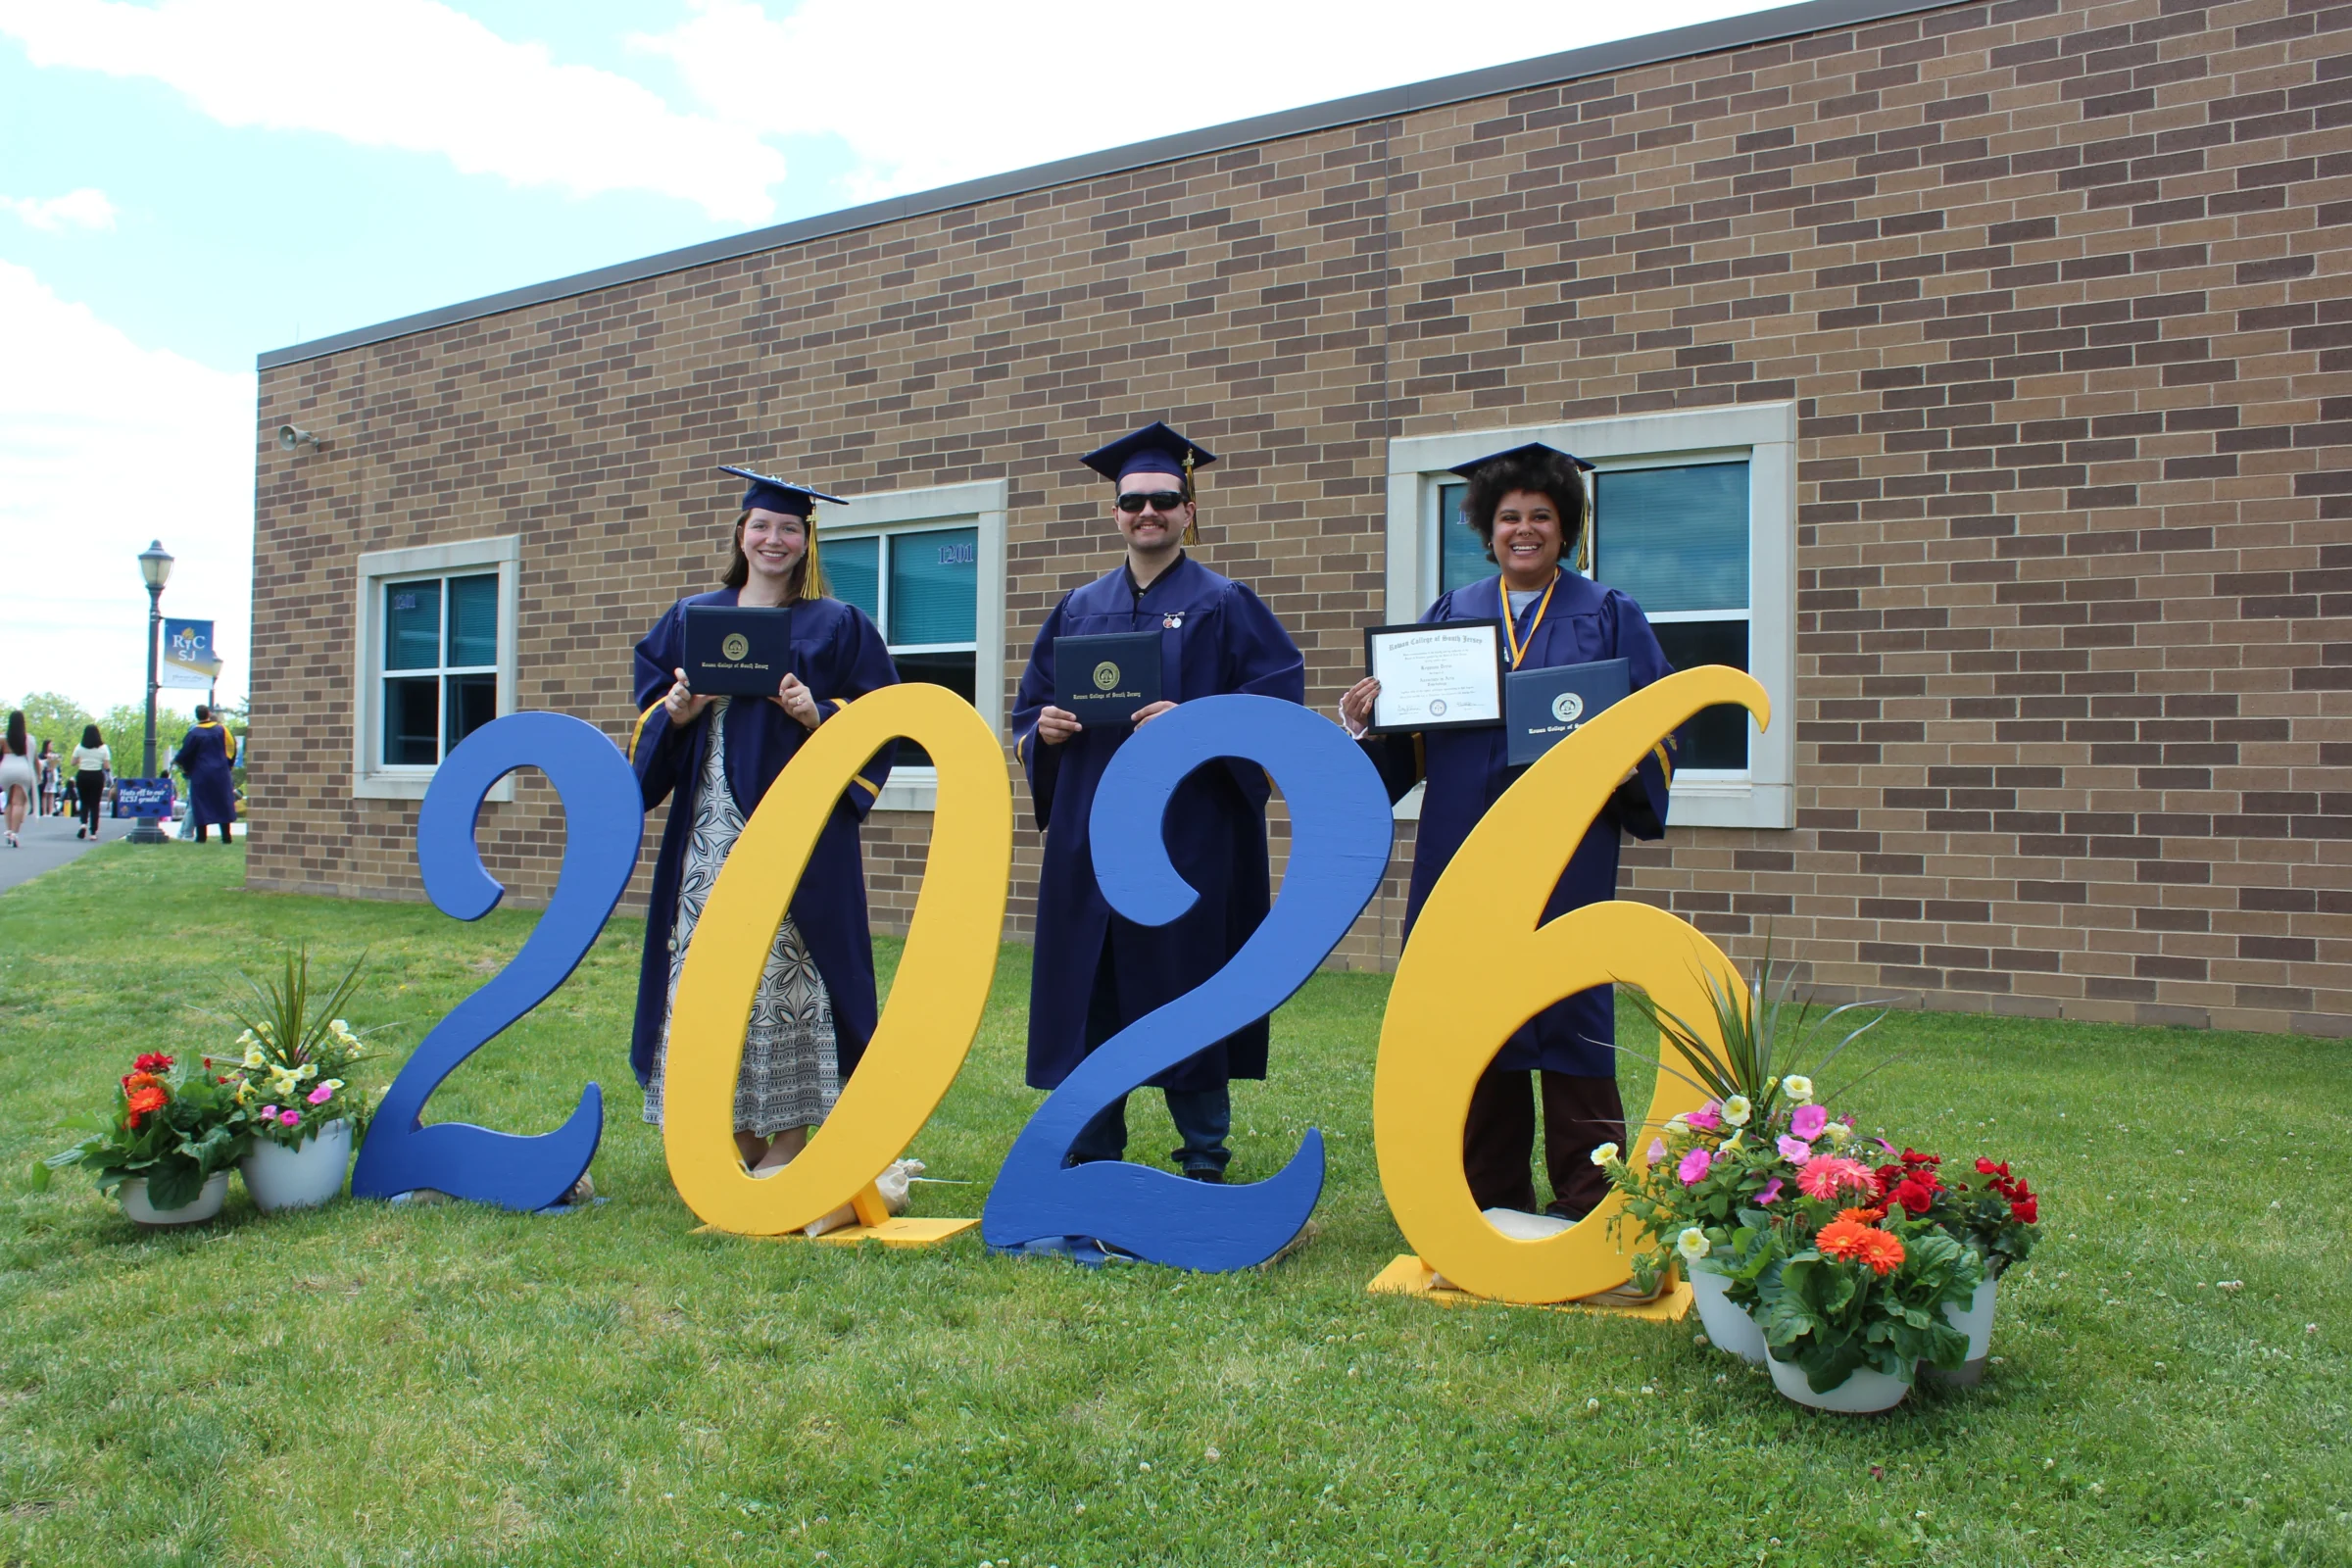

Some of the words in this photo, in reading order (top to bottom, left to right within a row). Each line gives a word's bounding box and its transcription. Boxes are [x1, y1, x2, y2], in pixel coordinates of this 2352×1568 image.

[938, 543, 974, 564] 1201
[1389, 641, 1409, 651] Rowan
[1410, 637, 1433, 646] College
[1462, 635, 1483, 645] Jersey
[178, 650, 196, 662] SJ
[136, 788, 146, 797] off
[351, 664, 1771, 1304] 2026
